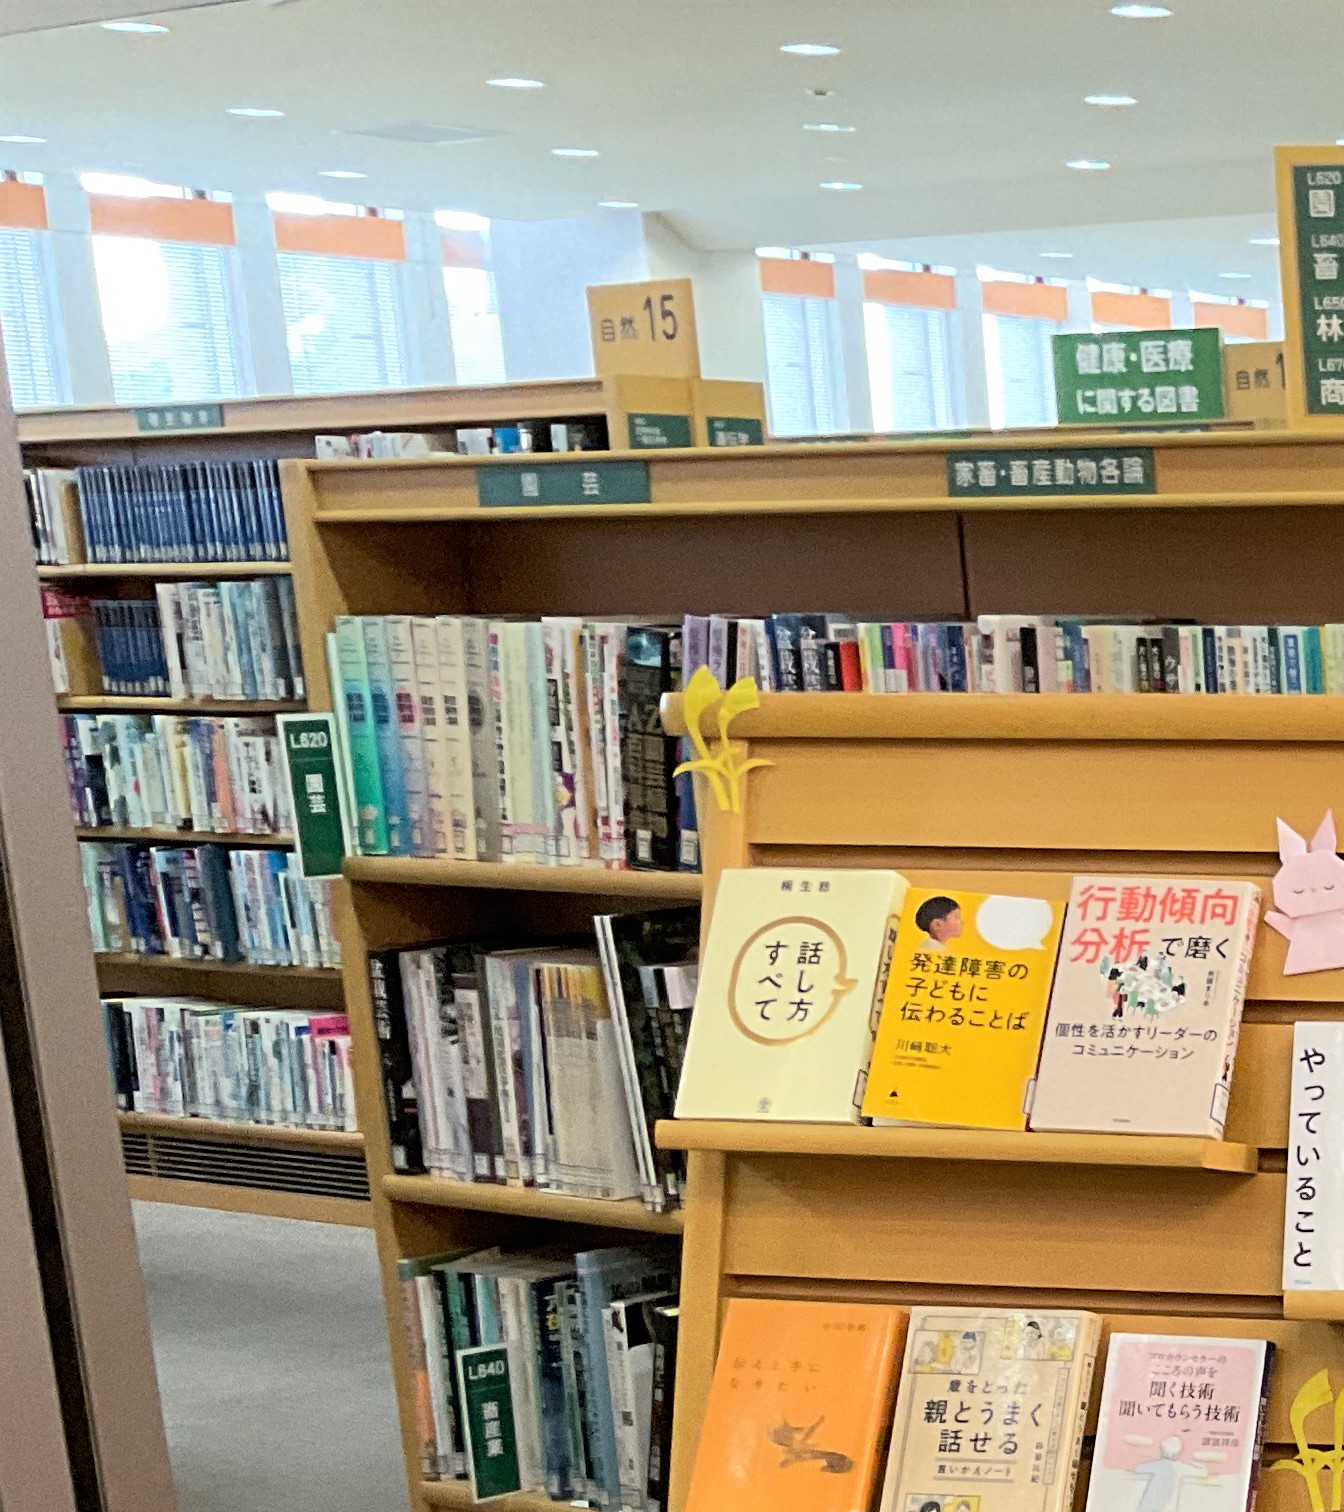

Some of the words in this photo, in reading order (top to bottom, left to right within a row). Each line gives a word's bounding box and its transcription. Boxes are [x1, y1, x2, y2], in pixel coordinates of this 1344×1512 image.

[600, 315, 639, 342] 自然
[642, 293, 679, 342] 15
[1074, 339, 1195, 375] 健康・医療
[1075, 384, 1201, 415] に関する図書
[288, 731, 328, 749] L620
[1078, 884, 1240, 926] 行動傾向
[755, 940, 789, 1021] すべて
[909, 951, 1030, 981] 発達障害の
[787, 941, 825, 1022] 話し方
[904, 976, 989, 1003] 子どもに
[899, 1001, 1031, 1032] 伝わることば
[1055, 1022, 1219, 1042] 個性を活かすリーダーの
[1071, 1043, 1196, 1061] コミュニケーション
[1292, 1047, 1327, 1268] やっていること
[1148, 1380, 1217, 1400] 聞く技術
[923, 1399, 1044, 1428] 親とうまく
[1118, 1399, 1242, 1423] 聞いてもらう技術
[938, 1428, 1019, 1455] 話せる
[937, 1463, 1013, 1478] 言いかえノート
